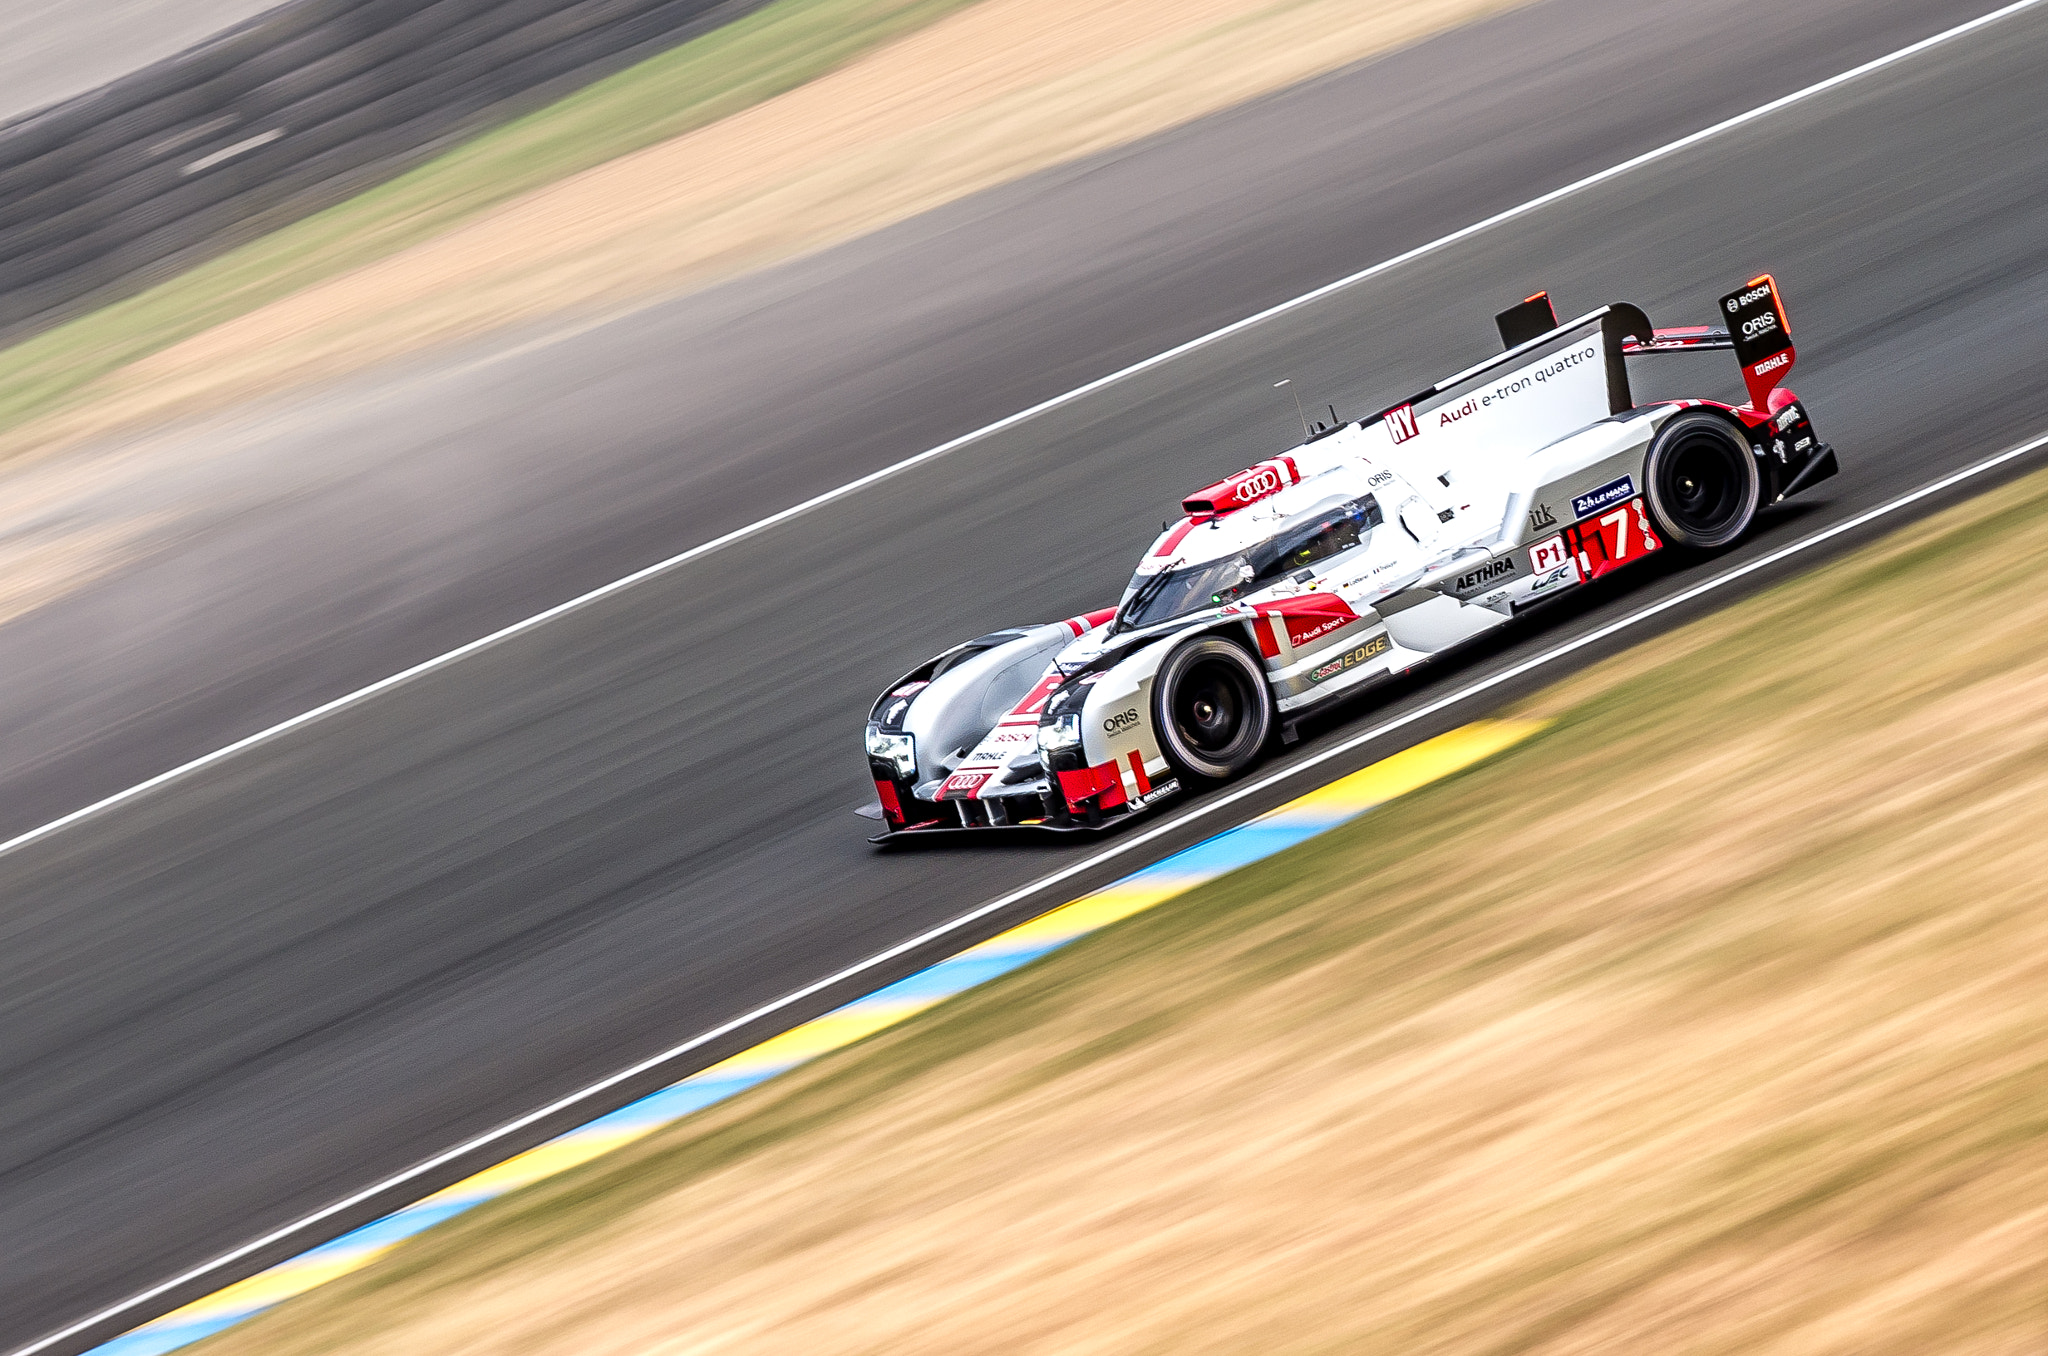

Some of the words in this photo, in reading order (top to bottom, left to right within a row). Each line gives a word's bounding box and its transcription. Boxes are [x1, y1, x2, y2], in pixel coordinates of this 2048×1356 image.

[1739, 284, 1771, 306] BOSCH
[1742, 311, 1775, 335] ORIS
[1754, 352, 1789, 376] MAHLE
[1440, 399, 1478, 428] Audi
[1481, 375, 1532, 407] e-tron
[1535, 347, 1595, 386] quattro
[1384, 404, 1418, 443] HY
[1367, 469, 1393, 487] ORIS
[1600, 508, 1628, 560] 7
[1535, 543, 1561, 570] P1
[1456, 557, 1516, 592] AETHRA
[1531, 566, 1569, 591] WEC
[1302, 626, 1322, 640] Audi
[1322, 617, 1345, 633] Sport
[1344, 636, 1386, 668] EDGE
[1103, 708, 1139, 733] ORIS
